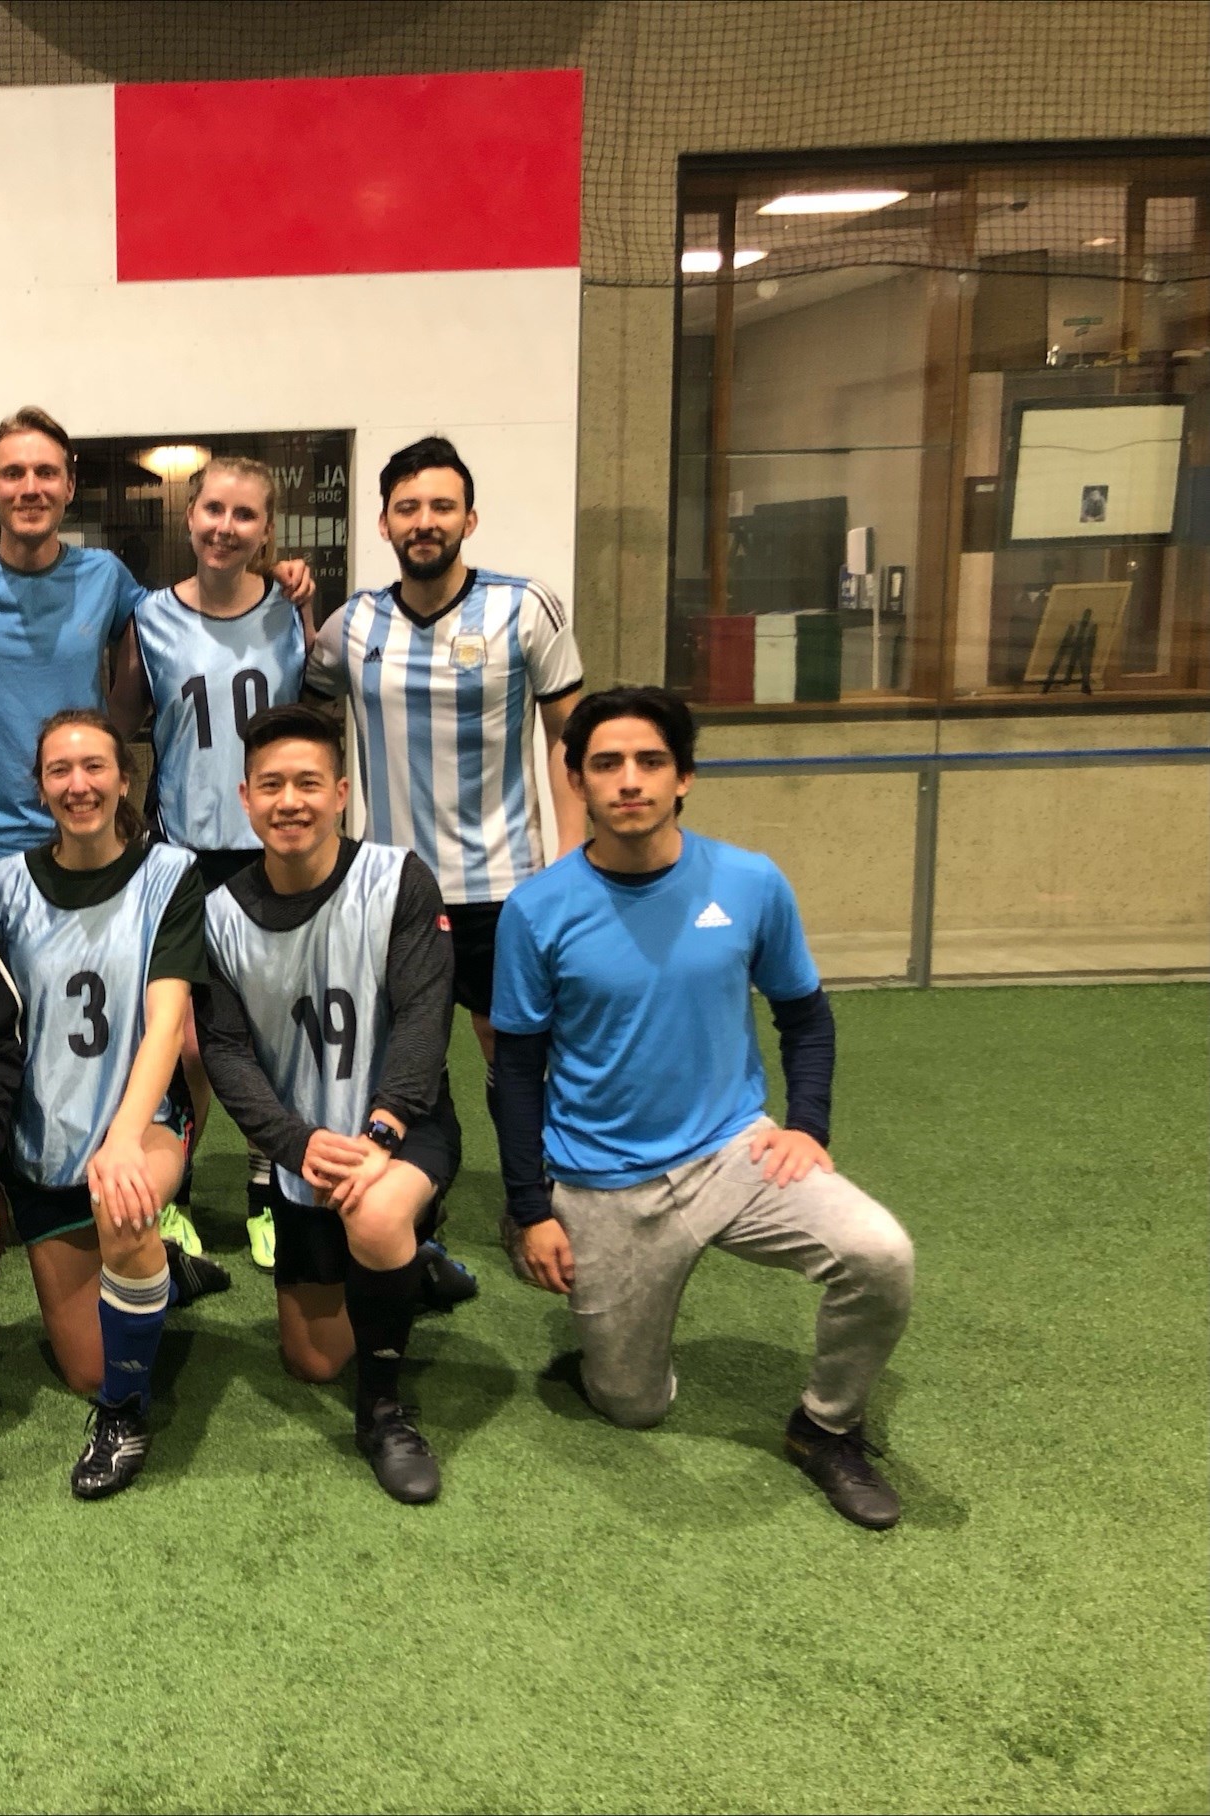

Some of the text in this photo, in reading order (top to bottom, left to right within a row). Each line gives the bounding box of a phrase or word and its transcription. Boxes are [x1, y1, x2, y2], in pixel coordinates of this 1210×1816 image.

[181, 669, 269, 749] 10
[65, 971, 109, 1058] 3
[291, 987, 357, 1081] 19
